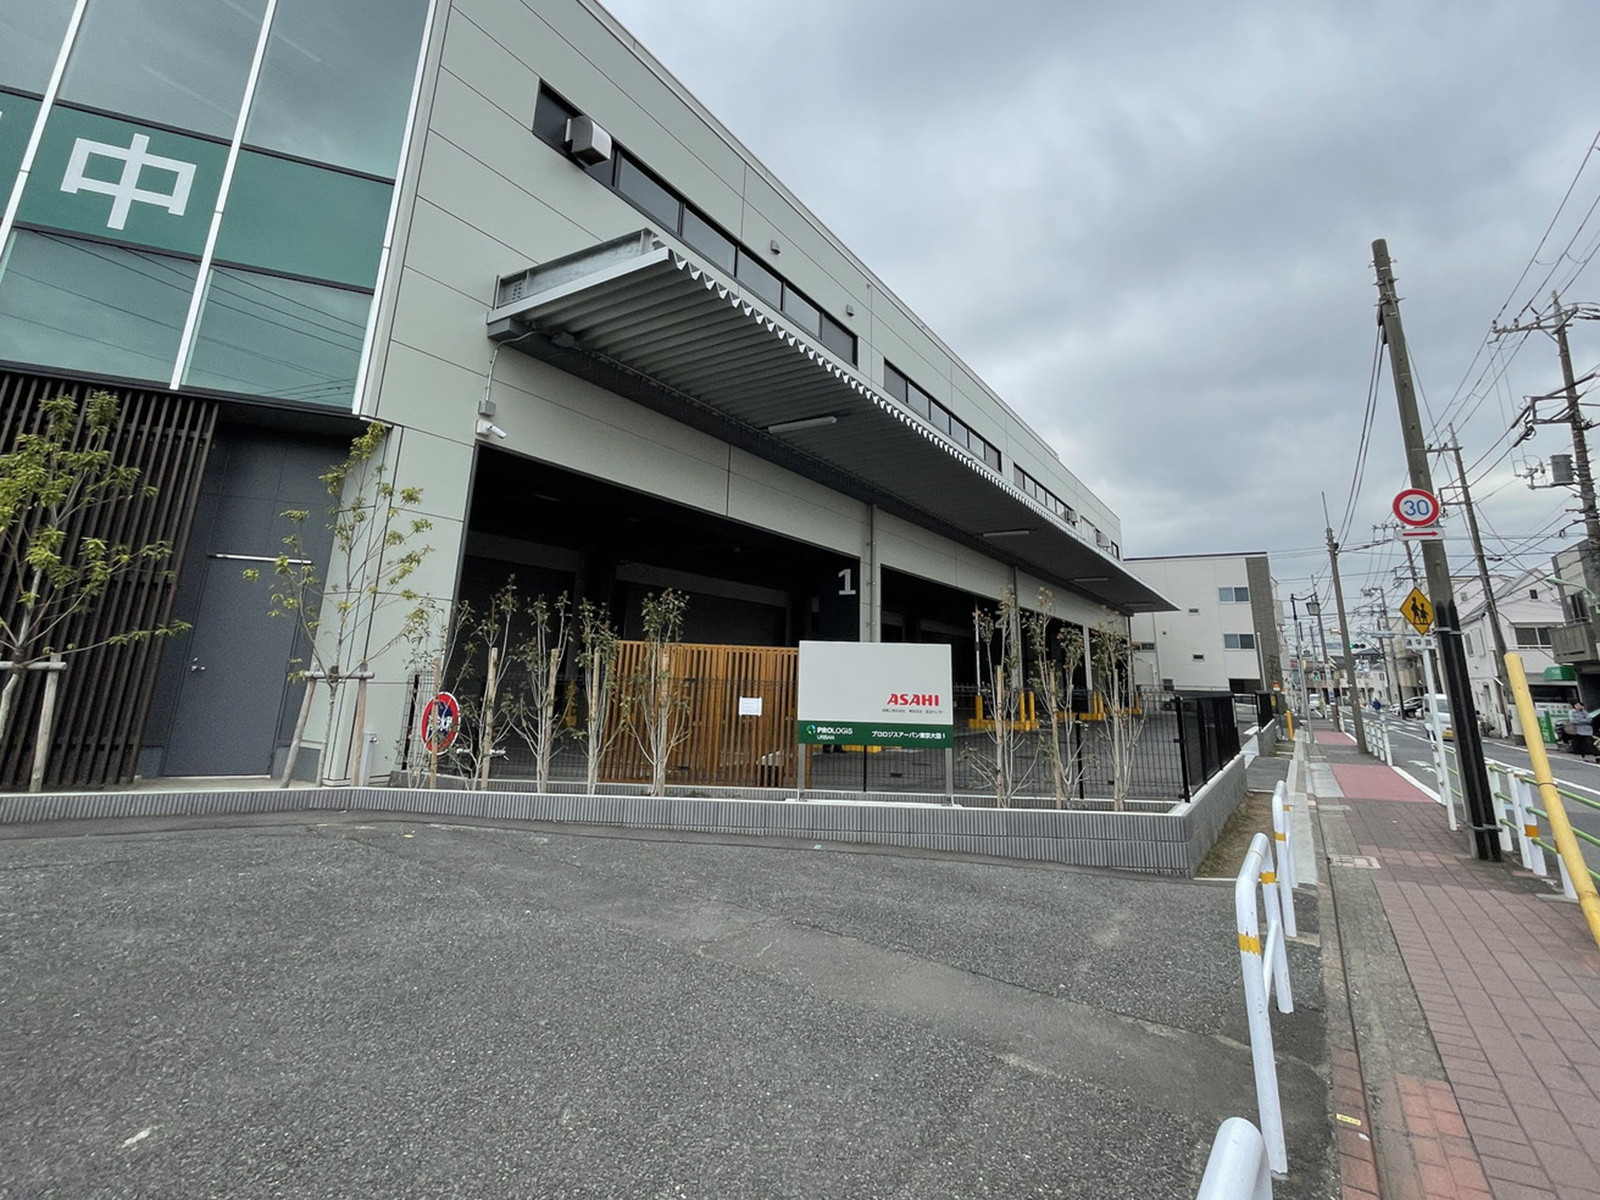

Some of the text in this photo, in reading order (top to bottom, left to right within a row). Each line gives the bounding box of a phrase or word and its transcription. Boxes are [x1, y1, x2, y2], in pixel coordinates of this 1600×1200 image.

[60, 133, 197, 230] 中
[1403, 499, 1430, 516] 30
[838, 568, 856, 596] 1
[886, 693, 940, 707] ASAHI
[816, 726, 853, 735] PROLOGIS
